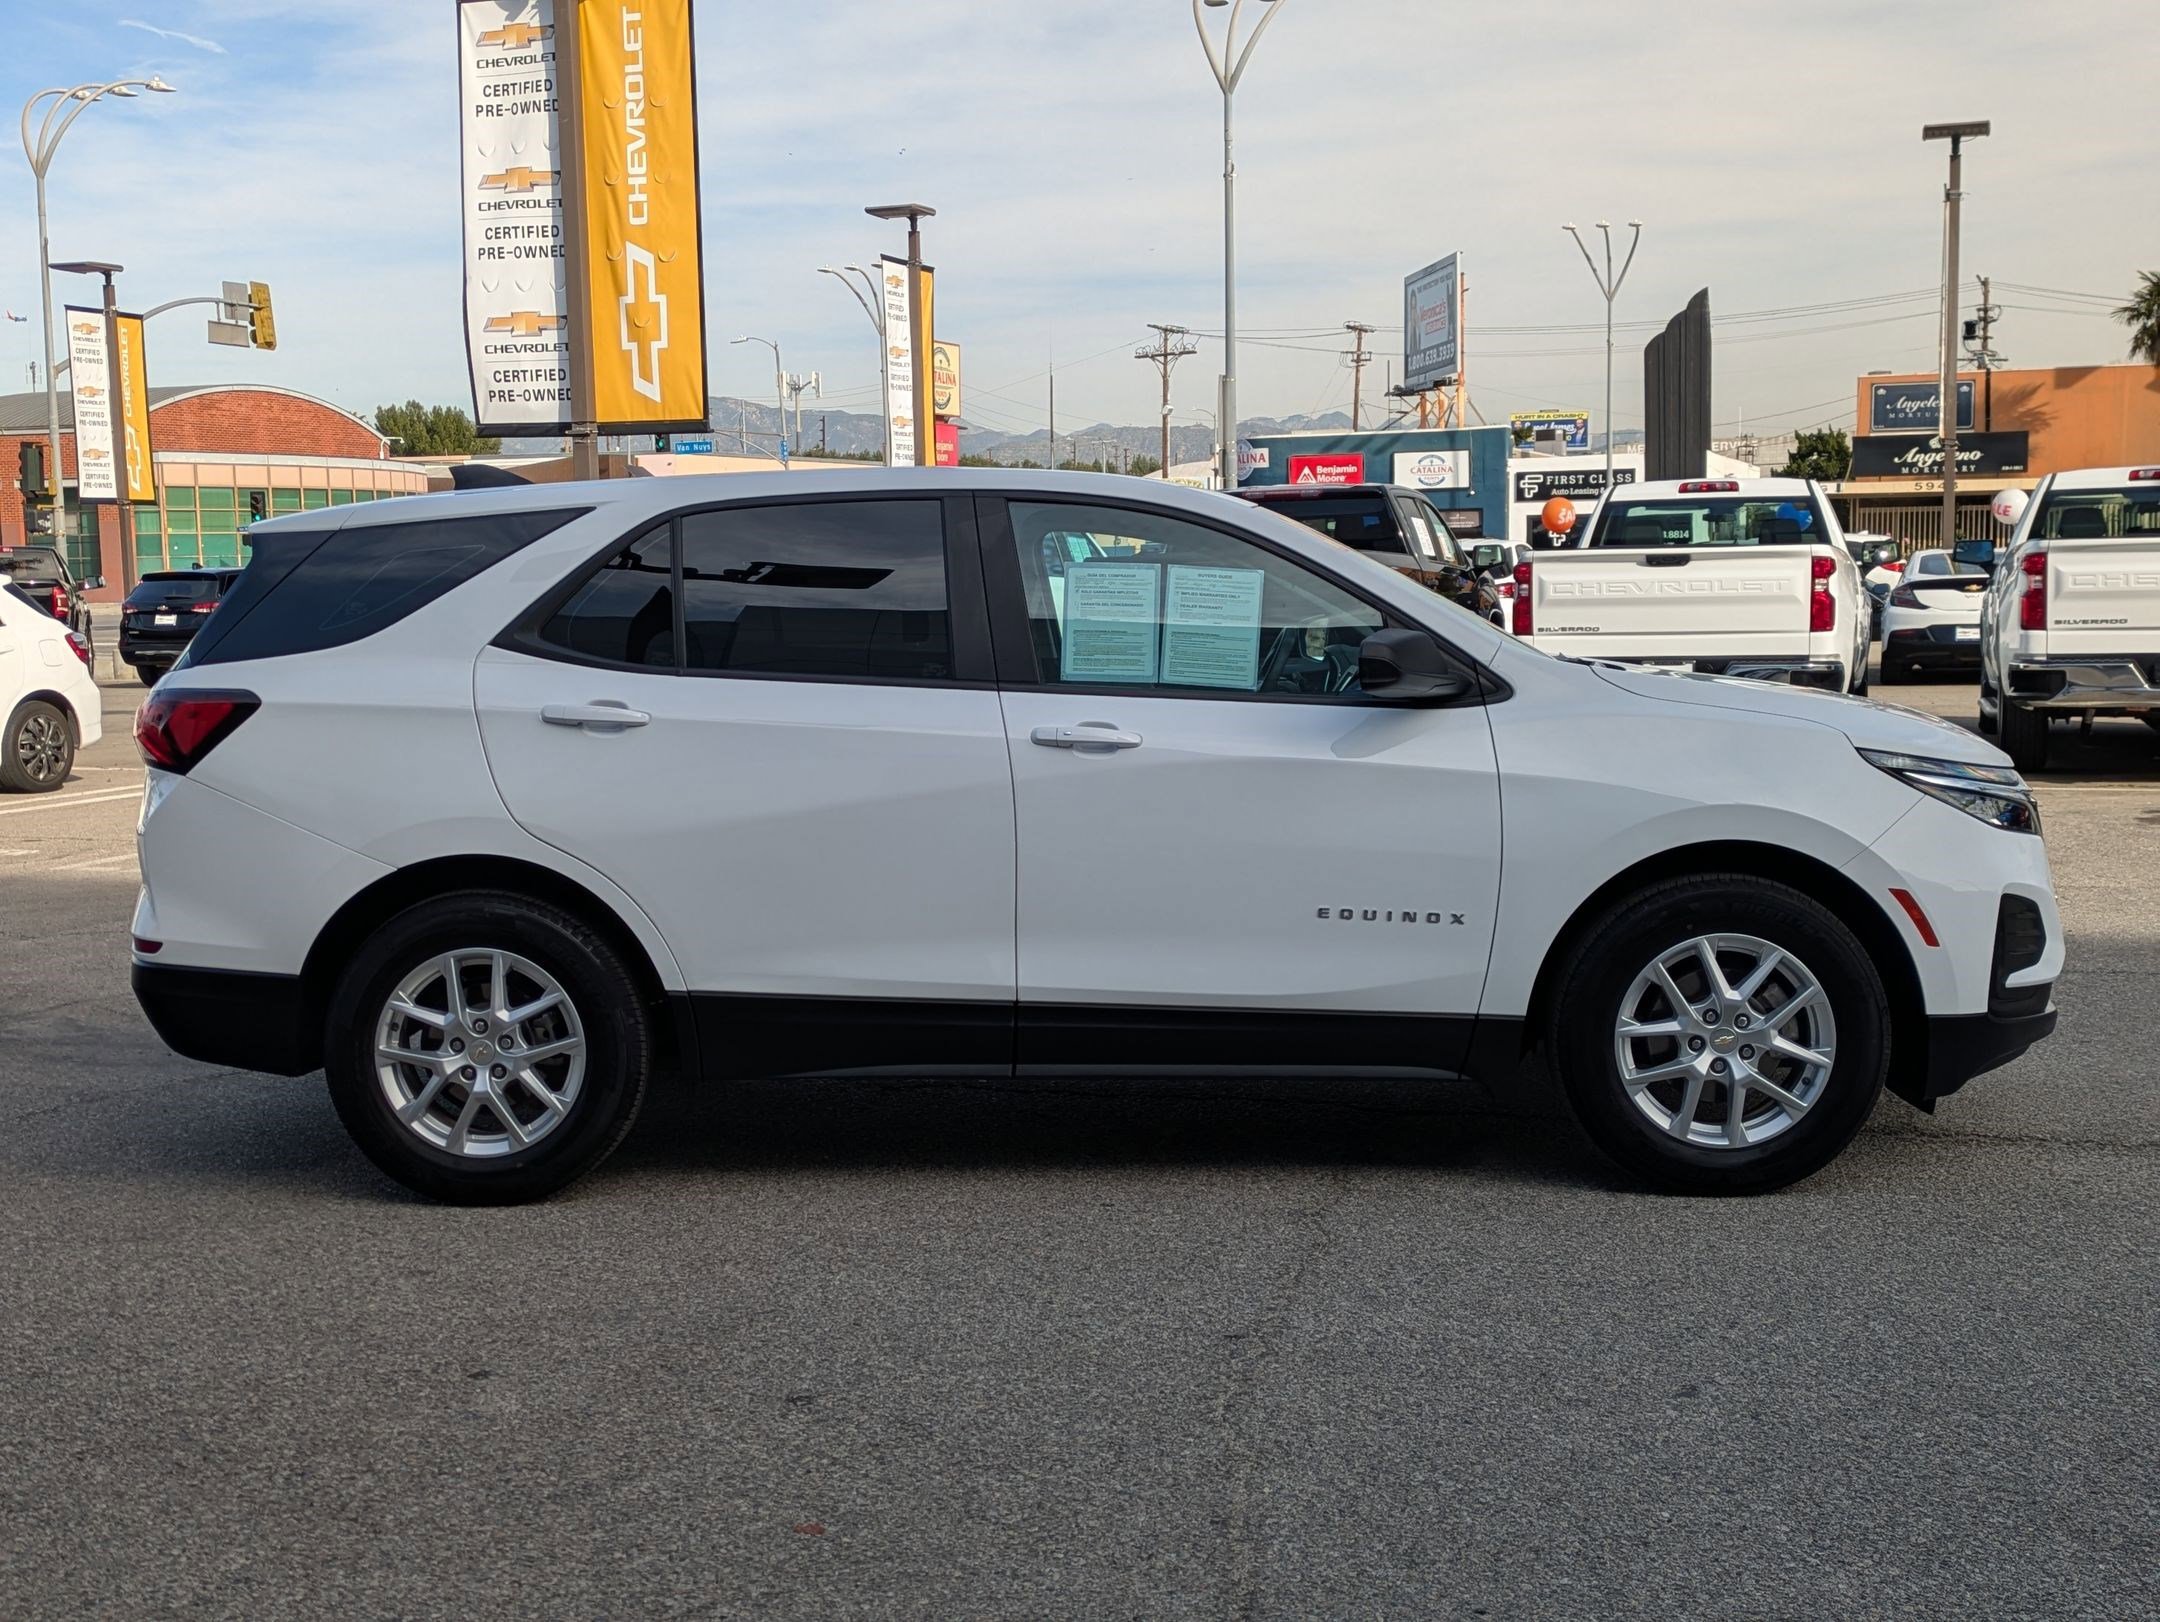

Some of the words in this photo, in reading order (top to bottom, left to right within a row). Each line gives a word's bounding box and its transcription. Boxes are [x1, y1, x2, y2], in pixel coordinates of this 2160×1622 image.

[477, 52, 556, 69] CHEVROLET
[483, 79, 553, 97] CERTIFIED
[476, 99, 558, 117] PRE-OWNED
[623, 6, 648, 225] CHEVROLET
[478, 198, 563, 212] CHEVROLET
[485, 225, 560, 239] CERTIFIED
[478, 245, 565, 260] PRE-OWNED
[484, 343, 569, 354] CHEVROLET
[493, 368, 566, 383] CERTIFIED
[934, 371, 957, 387] TALINA
[489, 388, 571, 402] PRE-OWNED
[1886, 395, 1940, 413] Angele
[677, 444, 690, 452] Van
[693, 443, 711, 452] Nuys
[1627, 445, 1645, 454] ME
[1712, 441, 1759, 451] ERVICE
[1237, 453, 1266, 464] ALINA
[1893, 446, 1984, 467] Angeeno
[1316, 464, 1357, 475] Benjamin
[1410, 466, 1453, 474] CATALINA
[1901, 465, 1976, 474] MORTRY
[1317, 474, 1346, 483] Moore
[1546, 475, 1585, 485] FIRST
[1590, 473, 1632, 484] CLSS
[1551, 488, 1569, 496] Auto
[1570, 487, 1598, 496] Leasing
[1558, 507, 1576, 525] SA
[1550, 579, 1790, 597] CHEVROLET
[1317, 907, 1465, 925] EQUINOX
